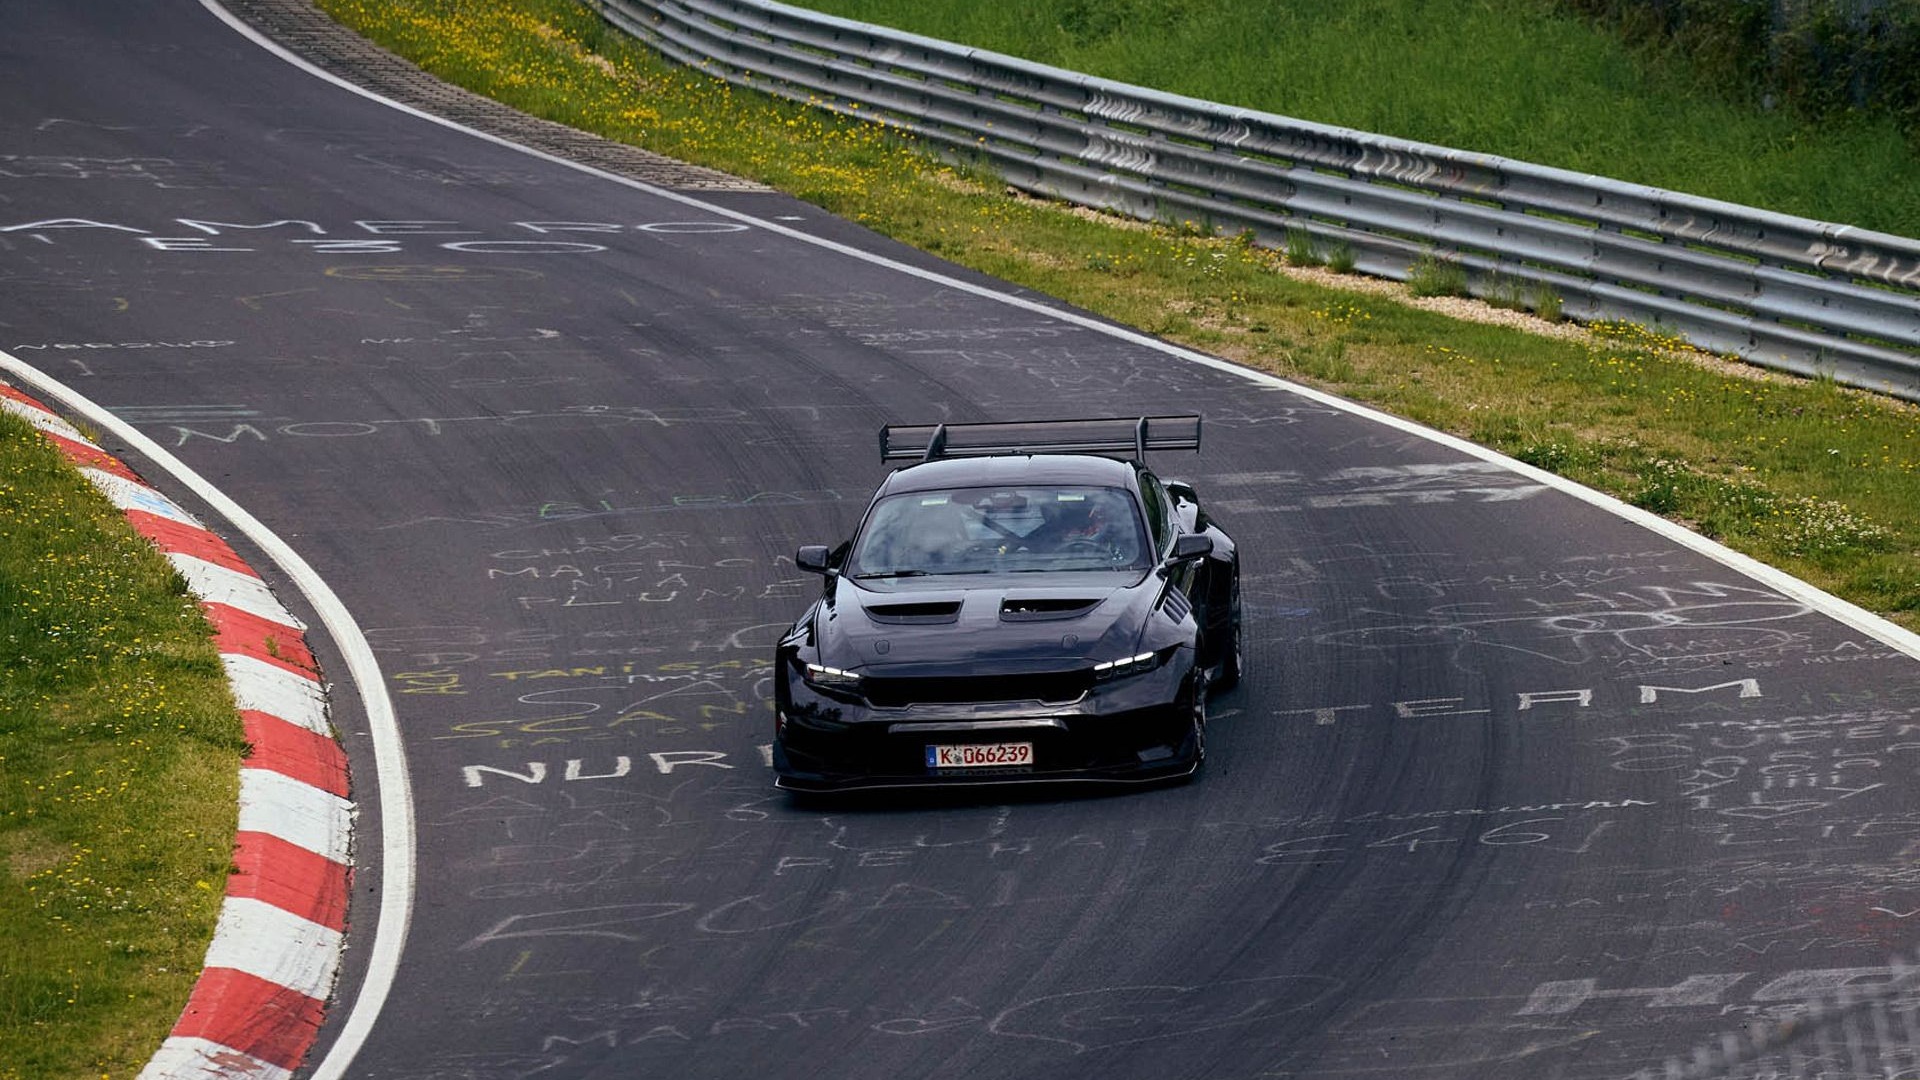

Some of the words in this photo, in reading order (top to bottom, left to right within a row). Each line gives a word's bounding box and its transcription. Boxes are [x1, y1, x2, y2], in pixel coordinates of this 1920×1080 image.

[1272, 678, 1764, 726] TEAM
[941, 748, 952, 764] K
[964, 746, 1029, 764] 066239
